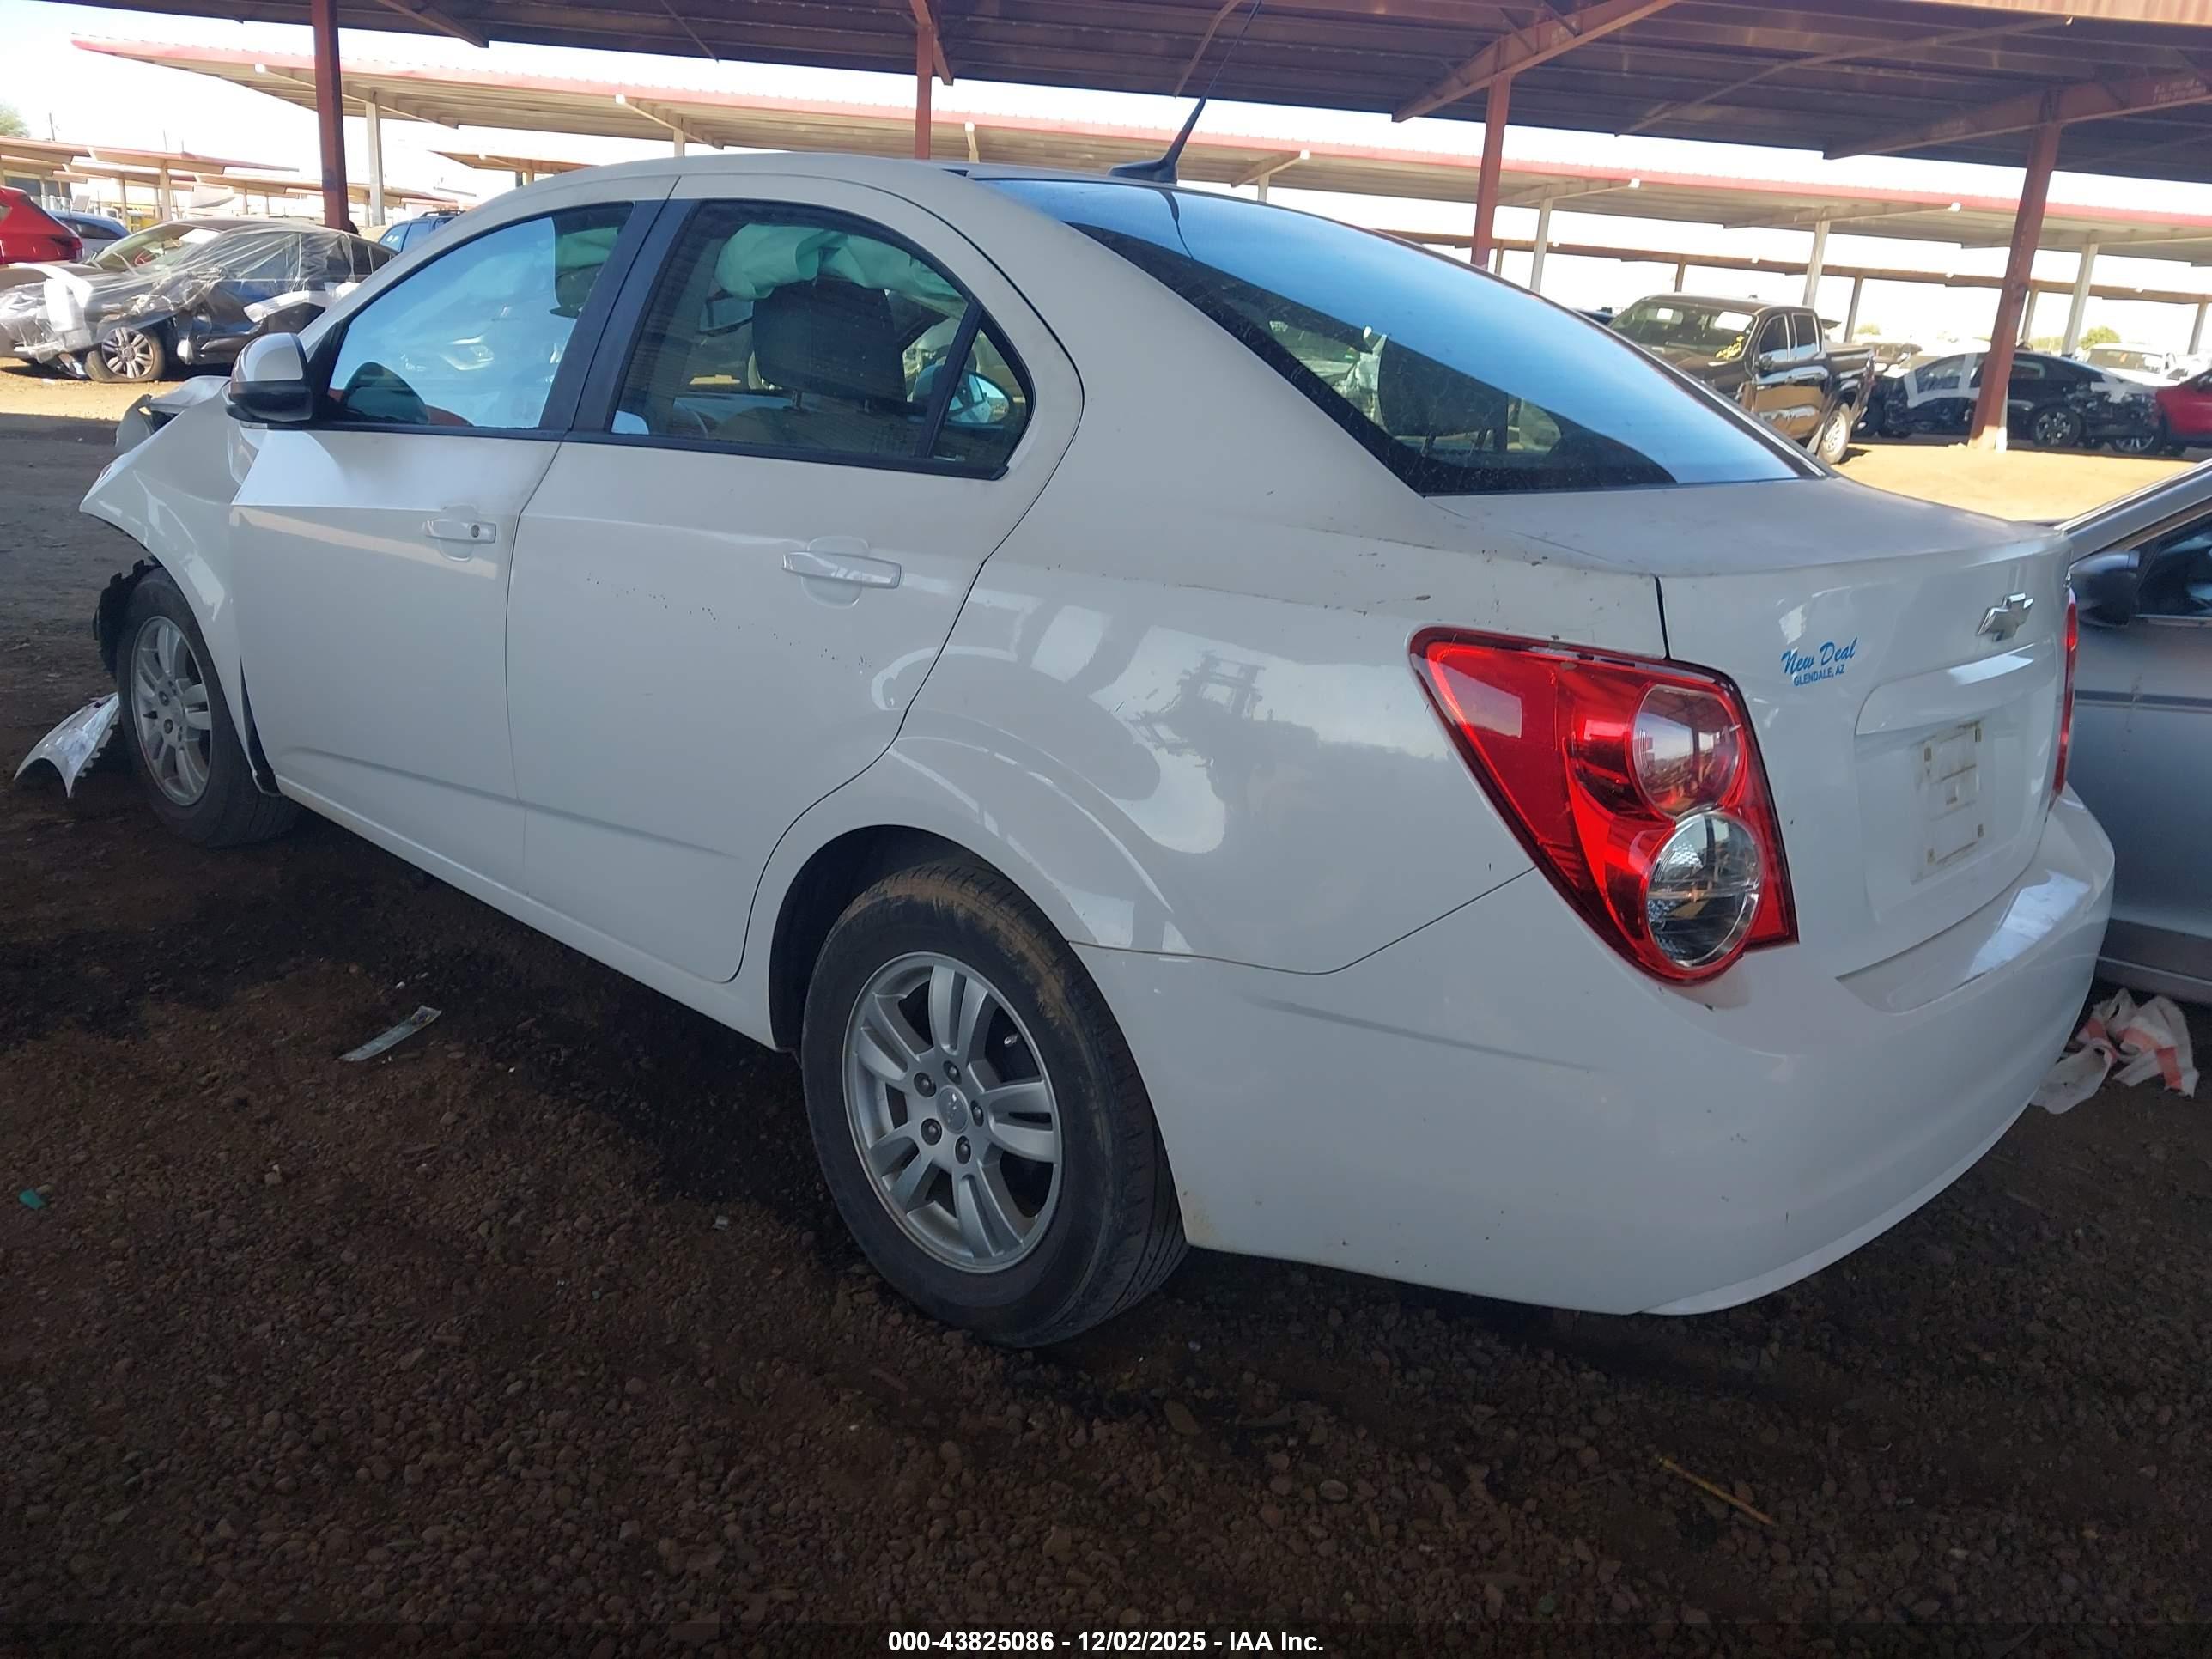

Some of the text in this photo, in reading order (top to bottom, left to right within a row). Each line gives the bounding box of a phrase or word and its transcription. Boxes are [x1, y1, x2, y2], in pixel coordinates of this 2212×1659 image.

[1781, 636, 1858, 675] New Deal
[1794, 664, 1844, 686] GLENDALE, AZ
